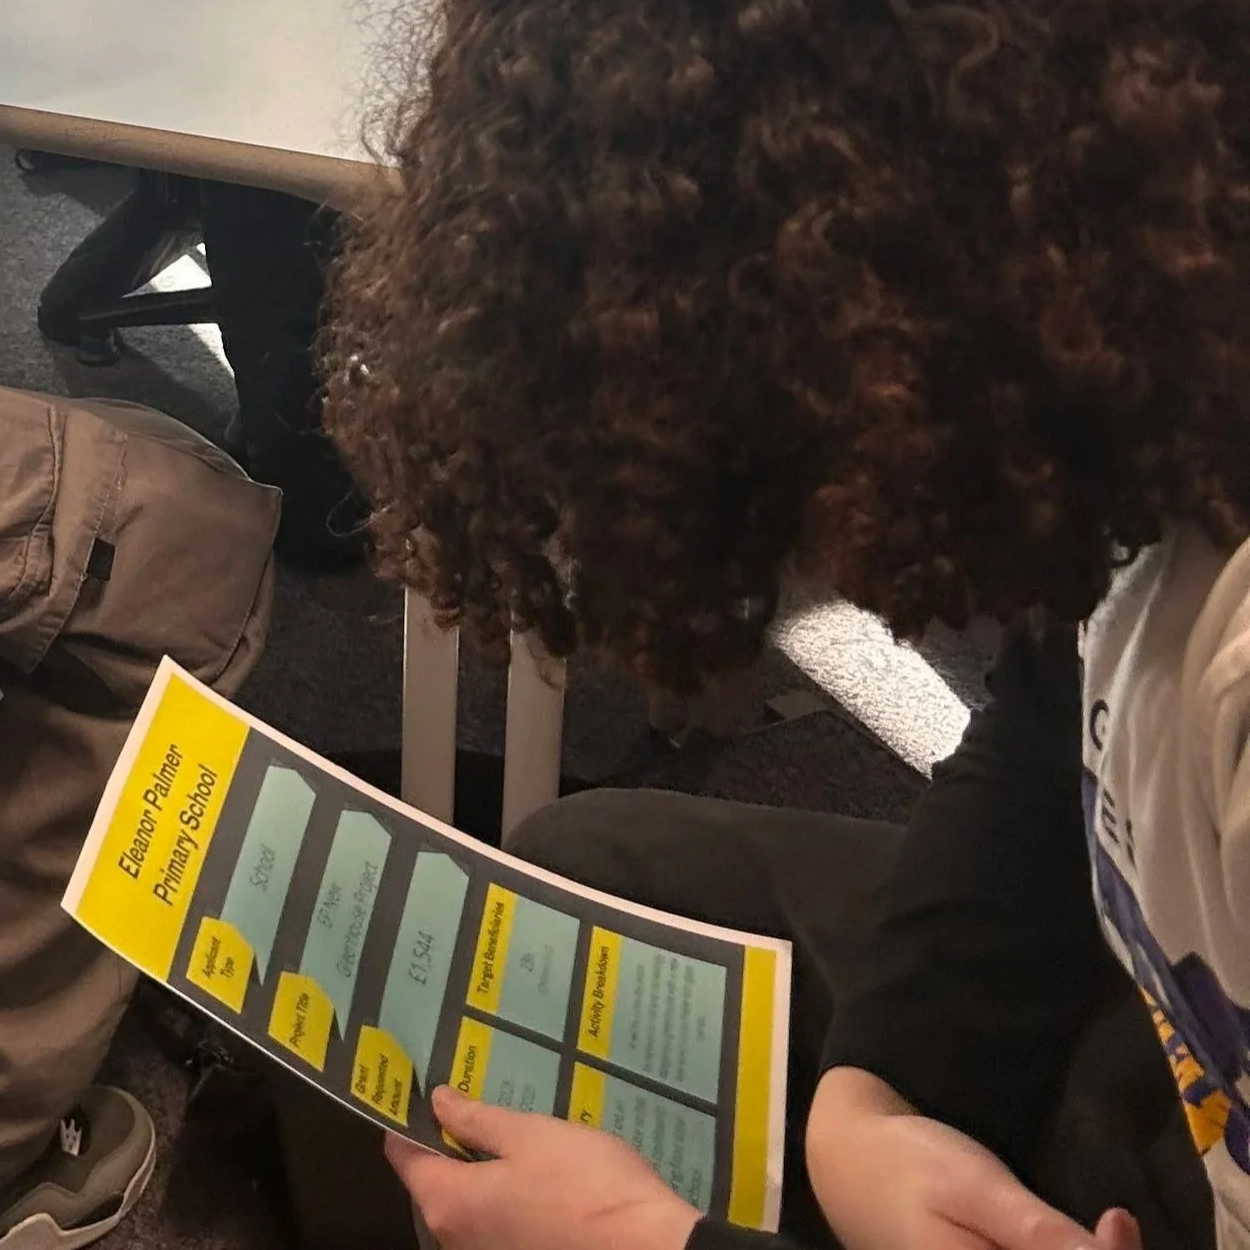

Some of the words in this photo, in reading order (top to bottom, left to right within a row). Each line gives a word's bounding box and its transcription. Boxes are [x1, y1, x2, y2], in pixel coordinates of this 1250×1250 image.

[118, 809, 158, 880] Eleanor
[143, 744, 183, 811] Palmer
[153, 829, 199, 906] Primary
[179, 763, 218, 831] School
[250, 842, 276, 892] School
[336, 909, 367, 979] Greenhouse
[352, 860, 378, 904] Project
[483, 901, 504, 960] Beneficiaries
[220, 956, 236, 979] Type
[408, 930, 435, 986] £1,544
[477, 960, 495, 994] Target
[592, 945, 610, 1000] Breakdown
[290, 1011, 307, 1048] Project
[588, 998, 605, 1039] Activity
[457, 1044, 477, 1093] Duration
